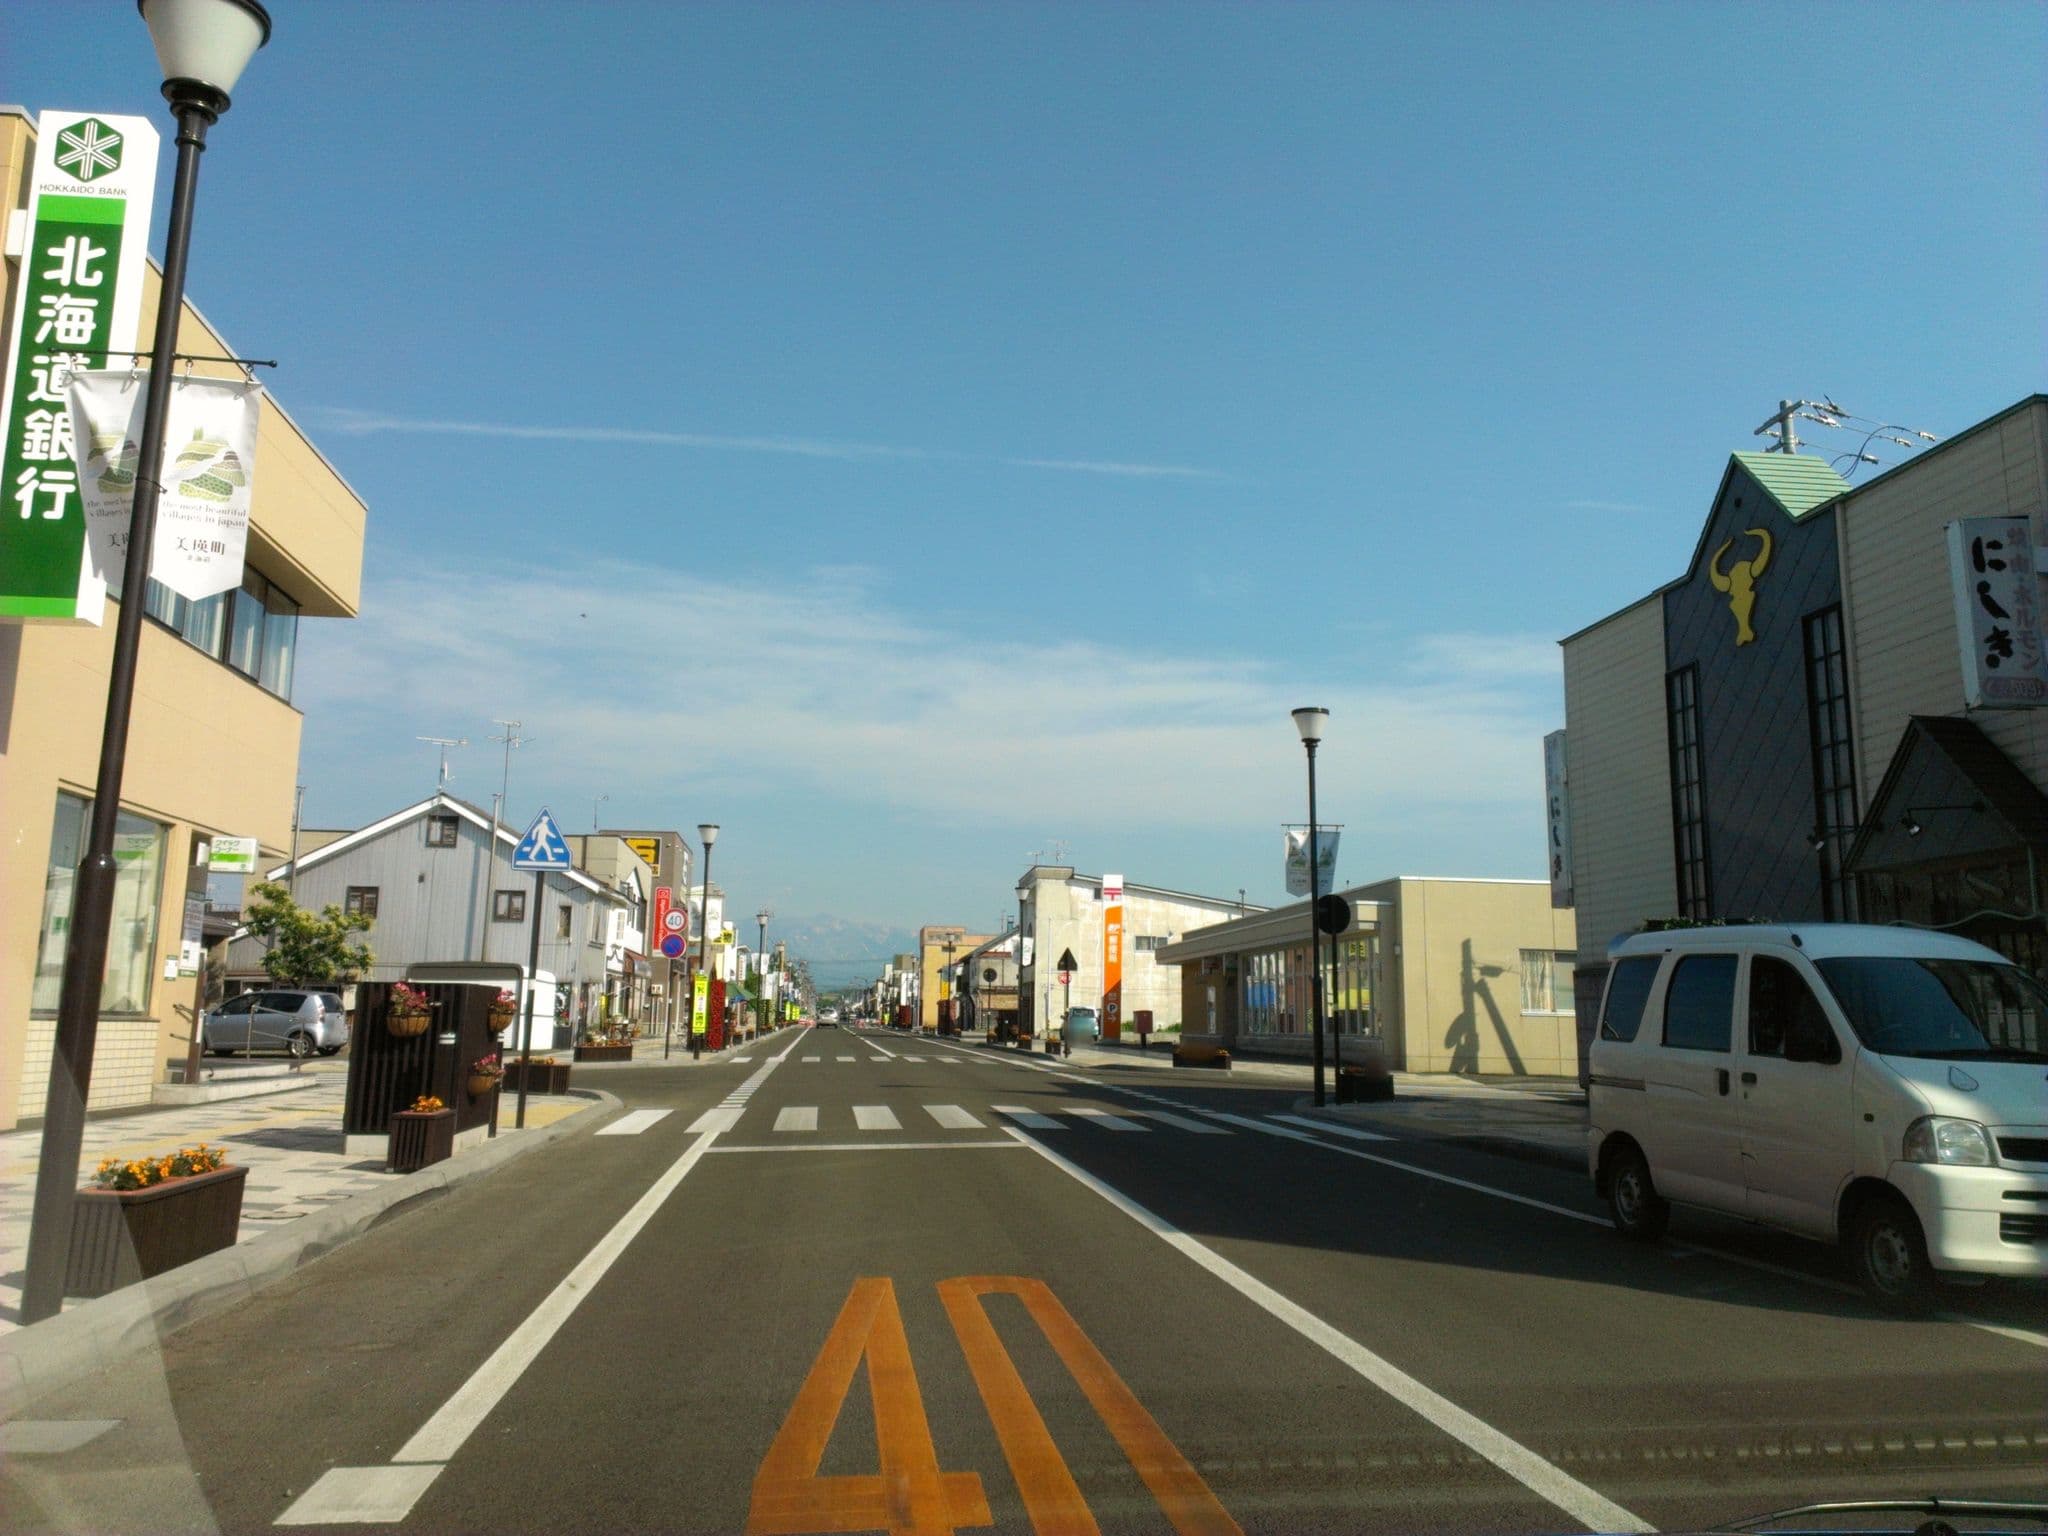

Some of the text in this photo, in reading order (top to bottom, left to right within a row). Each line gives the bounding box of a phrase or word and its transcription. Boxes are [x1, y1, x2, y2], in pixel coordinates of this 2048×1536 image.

[39, 184, 127, 195] HOKKAIDO BANK
[15, 235, 106, 520] 北海道銀行
[205, 504, 246, 517] beautiful
[1972, 536, 2014, 669] にしき
[1550, 796, 1562, 880] にしき
[668, 915, 682, 929] 40
[745, 1276, 1246, 1536] 40
